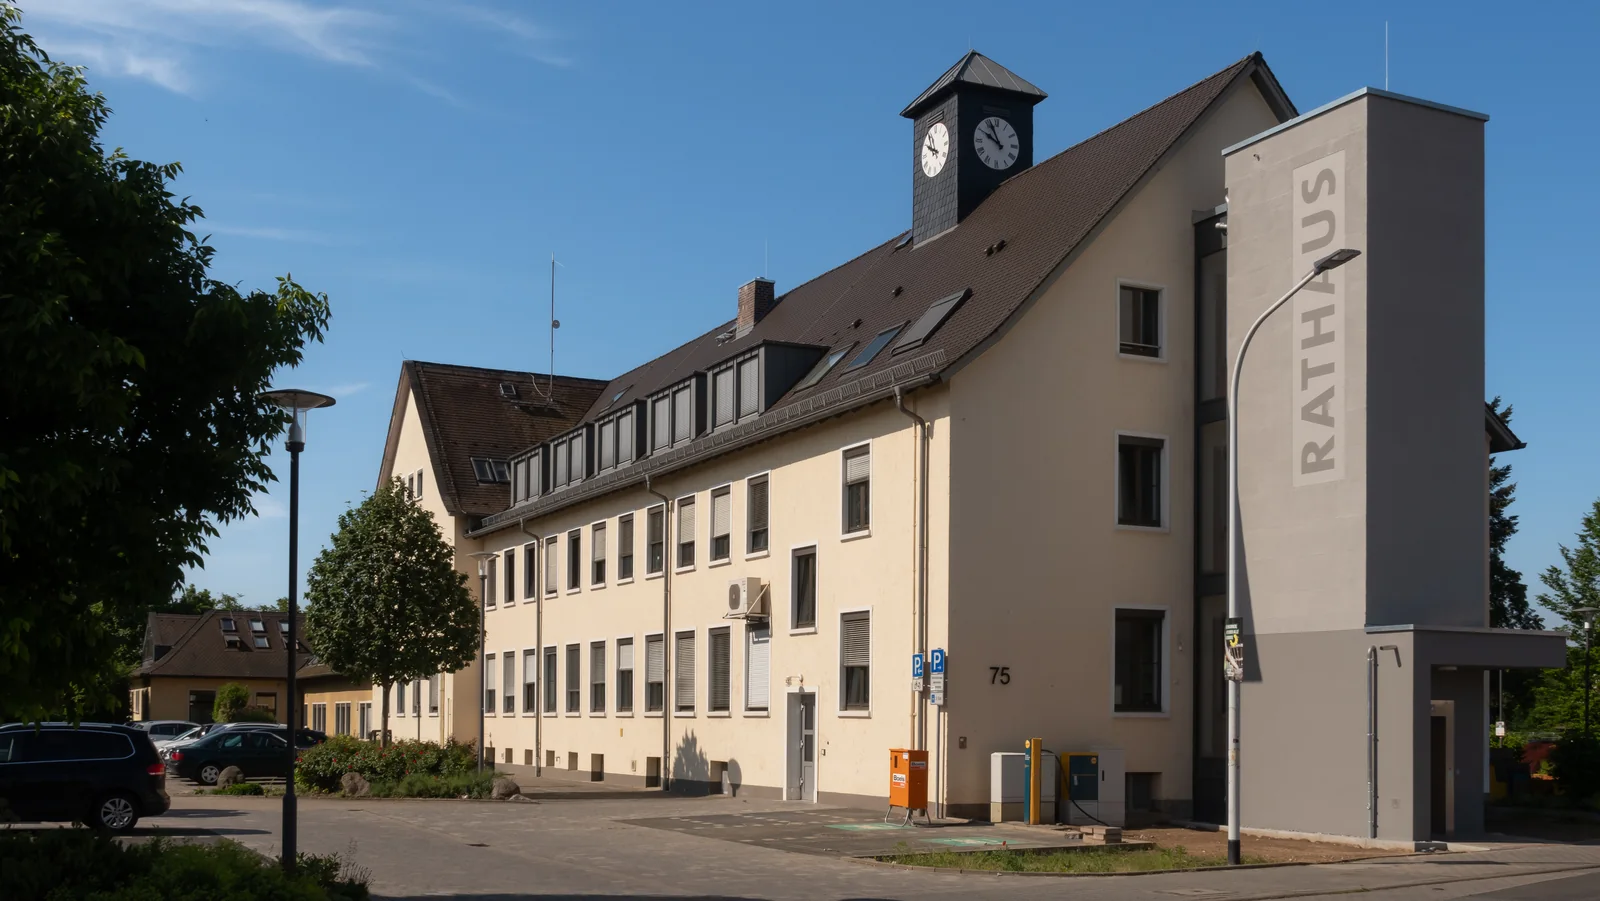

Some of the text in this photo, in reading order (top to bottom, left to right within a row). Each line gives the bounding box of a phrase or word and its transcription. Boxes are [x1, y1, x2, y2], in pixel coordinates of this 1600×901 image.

[914, 656, 921, 675] P
[933, 652, 942, 671] P
[989, 666, 1011, 685] 75
